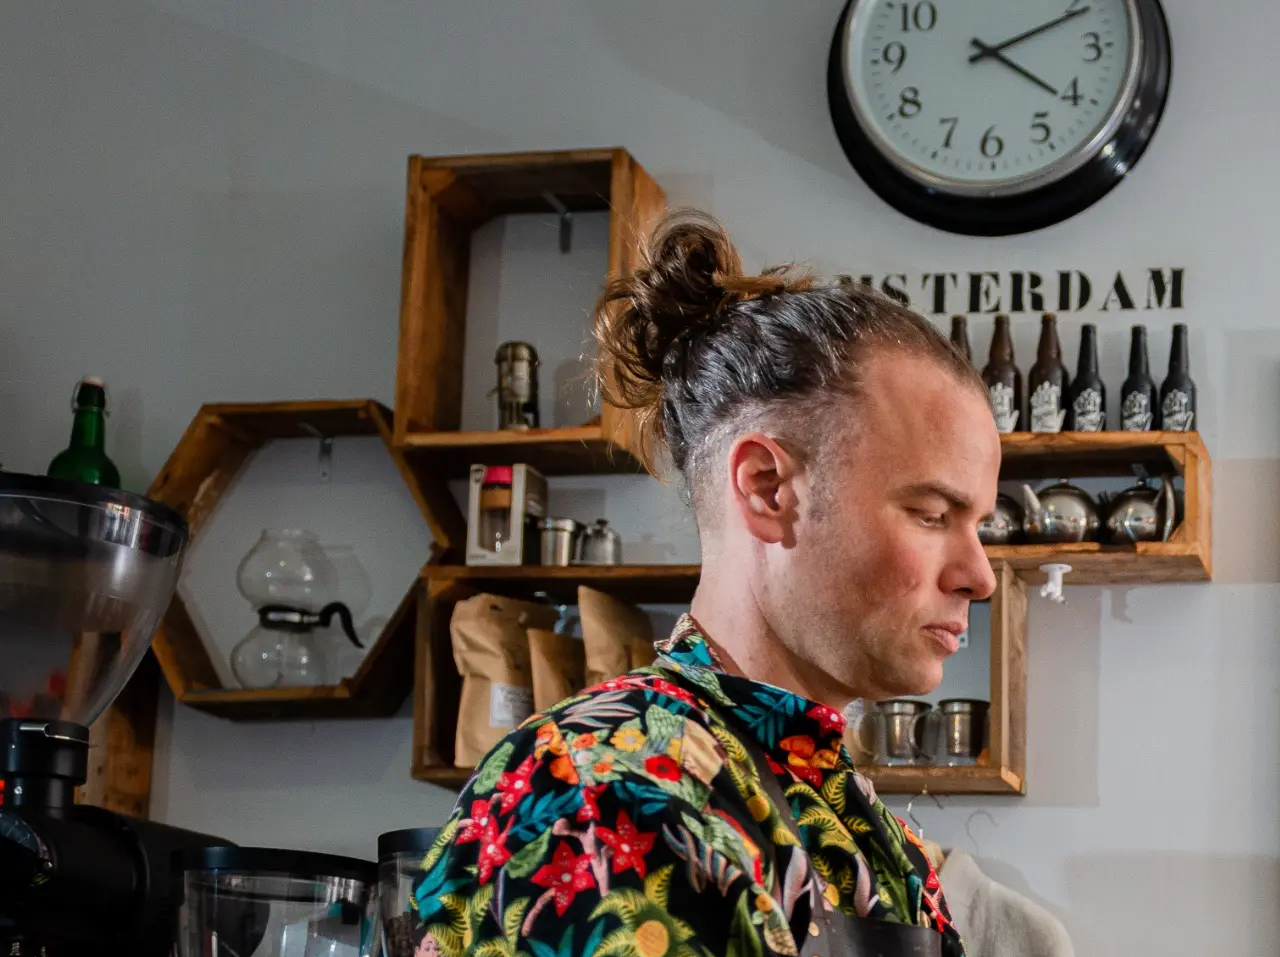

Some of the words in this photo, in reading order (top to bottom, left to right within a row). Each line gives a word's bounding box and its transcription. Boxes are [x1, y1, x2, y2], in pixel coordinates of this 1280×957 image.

[901, 0, 937, 31] 10
[882, 41, 906, 75] 9
[1081, 32, 1102, 62] 3
[898, 86, 922, 118] 8
[1060, 76, 1084, 107] 4
[939, 117, 959, 149] 7
[980, 124, 1004, 158] 6
[1030, 111, 1051, 144] 5
[834, 268, 1185, 314] STERDAM
